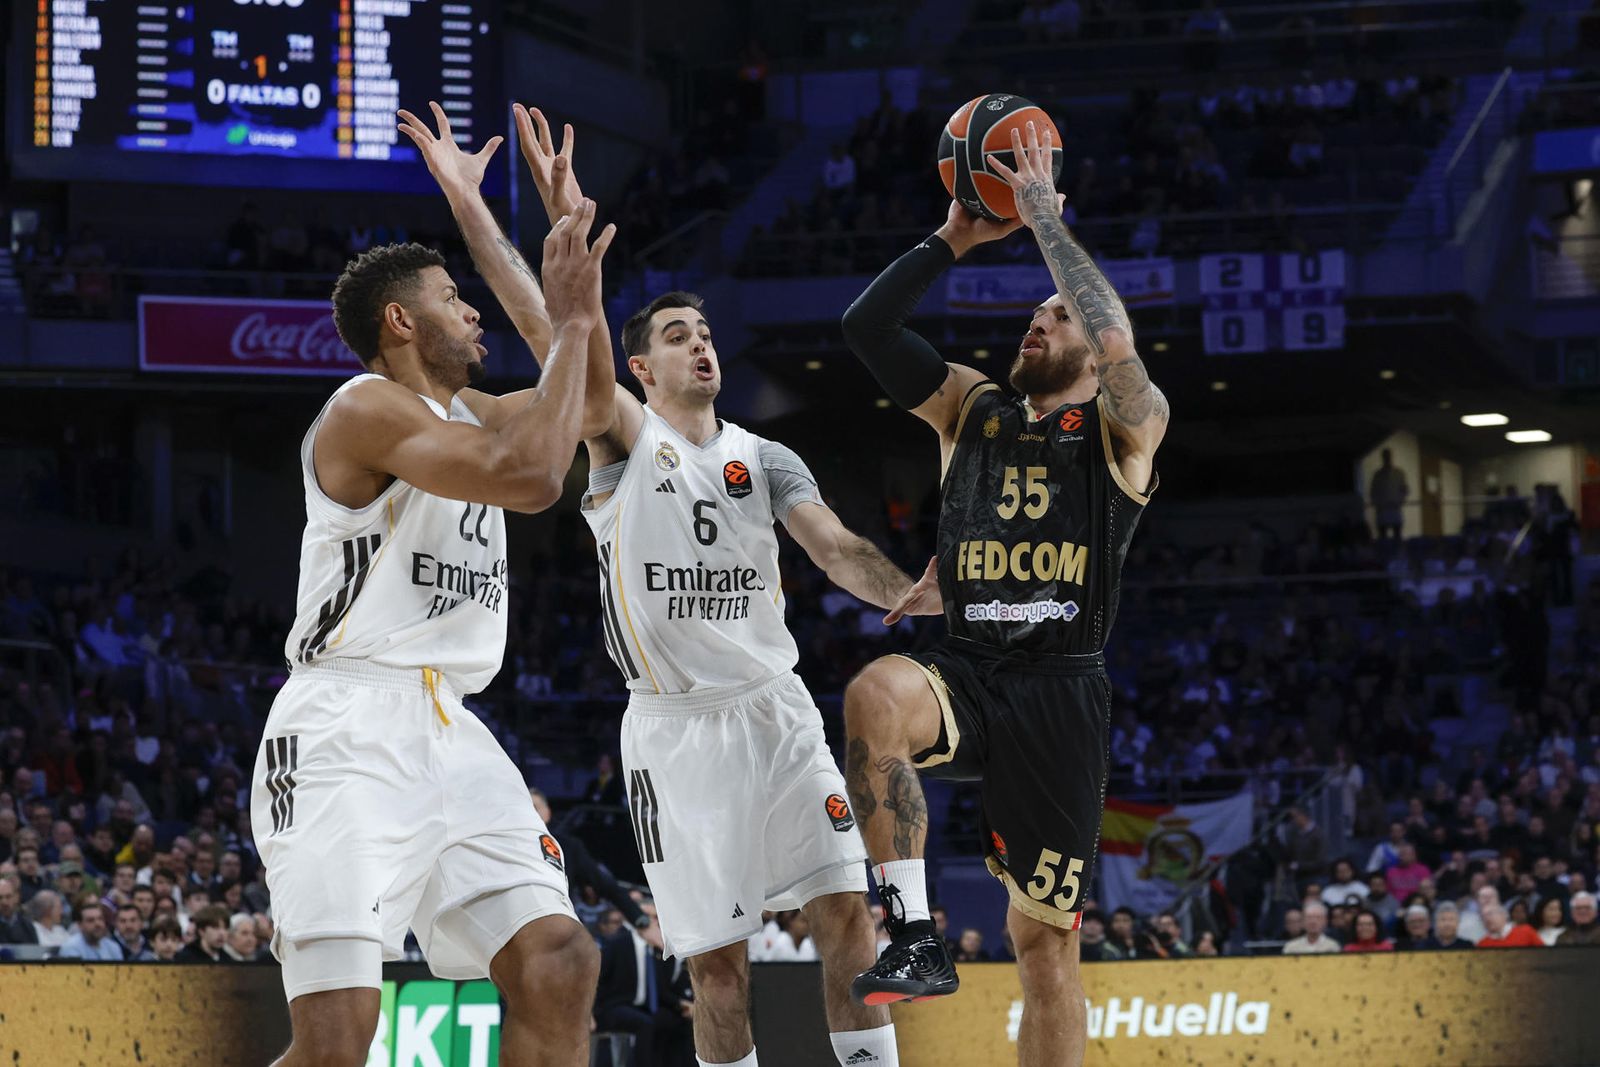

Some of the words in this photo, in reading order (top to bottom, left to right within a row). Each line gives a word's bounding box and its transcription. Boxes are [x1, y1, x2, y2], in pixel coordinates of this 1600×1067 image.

[254, 55, 267, 79] 1
[207, 79, 226, 104] 0
[227, 84, 299, 106] FALTAS
[302, 83, 321, 109] 0
[1219, 258, 1242, 287] 2
[1299, 253, 1321, 283] 0
[1223, 316, 1244, 348] 0
[1303, 313, 1326, 344] 9
[996, 466, 1050, 520] 55
[693, 499, 718, 546] 6
[643, 561, 766, 593] Emirates
[957, 540, 1089, 586] FEDCOM
[667, 596, 696, 620] FLY
[699, 595, 749, 621] BETTER
[1027, 847, 1085, 911] 55
[1006, 992, 1270, 1042] #uHuella
[845, 1056, 879, 1066] adidas
